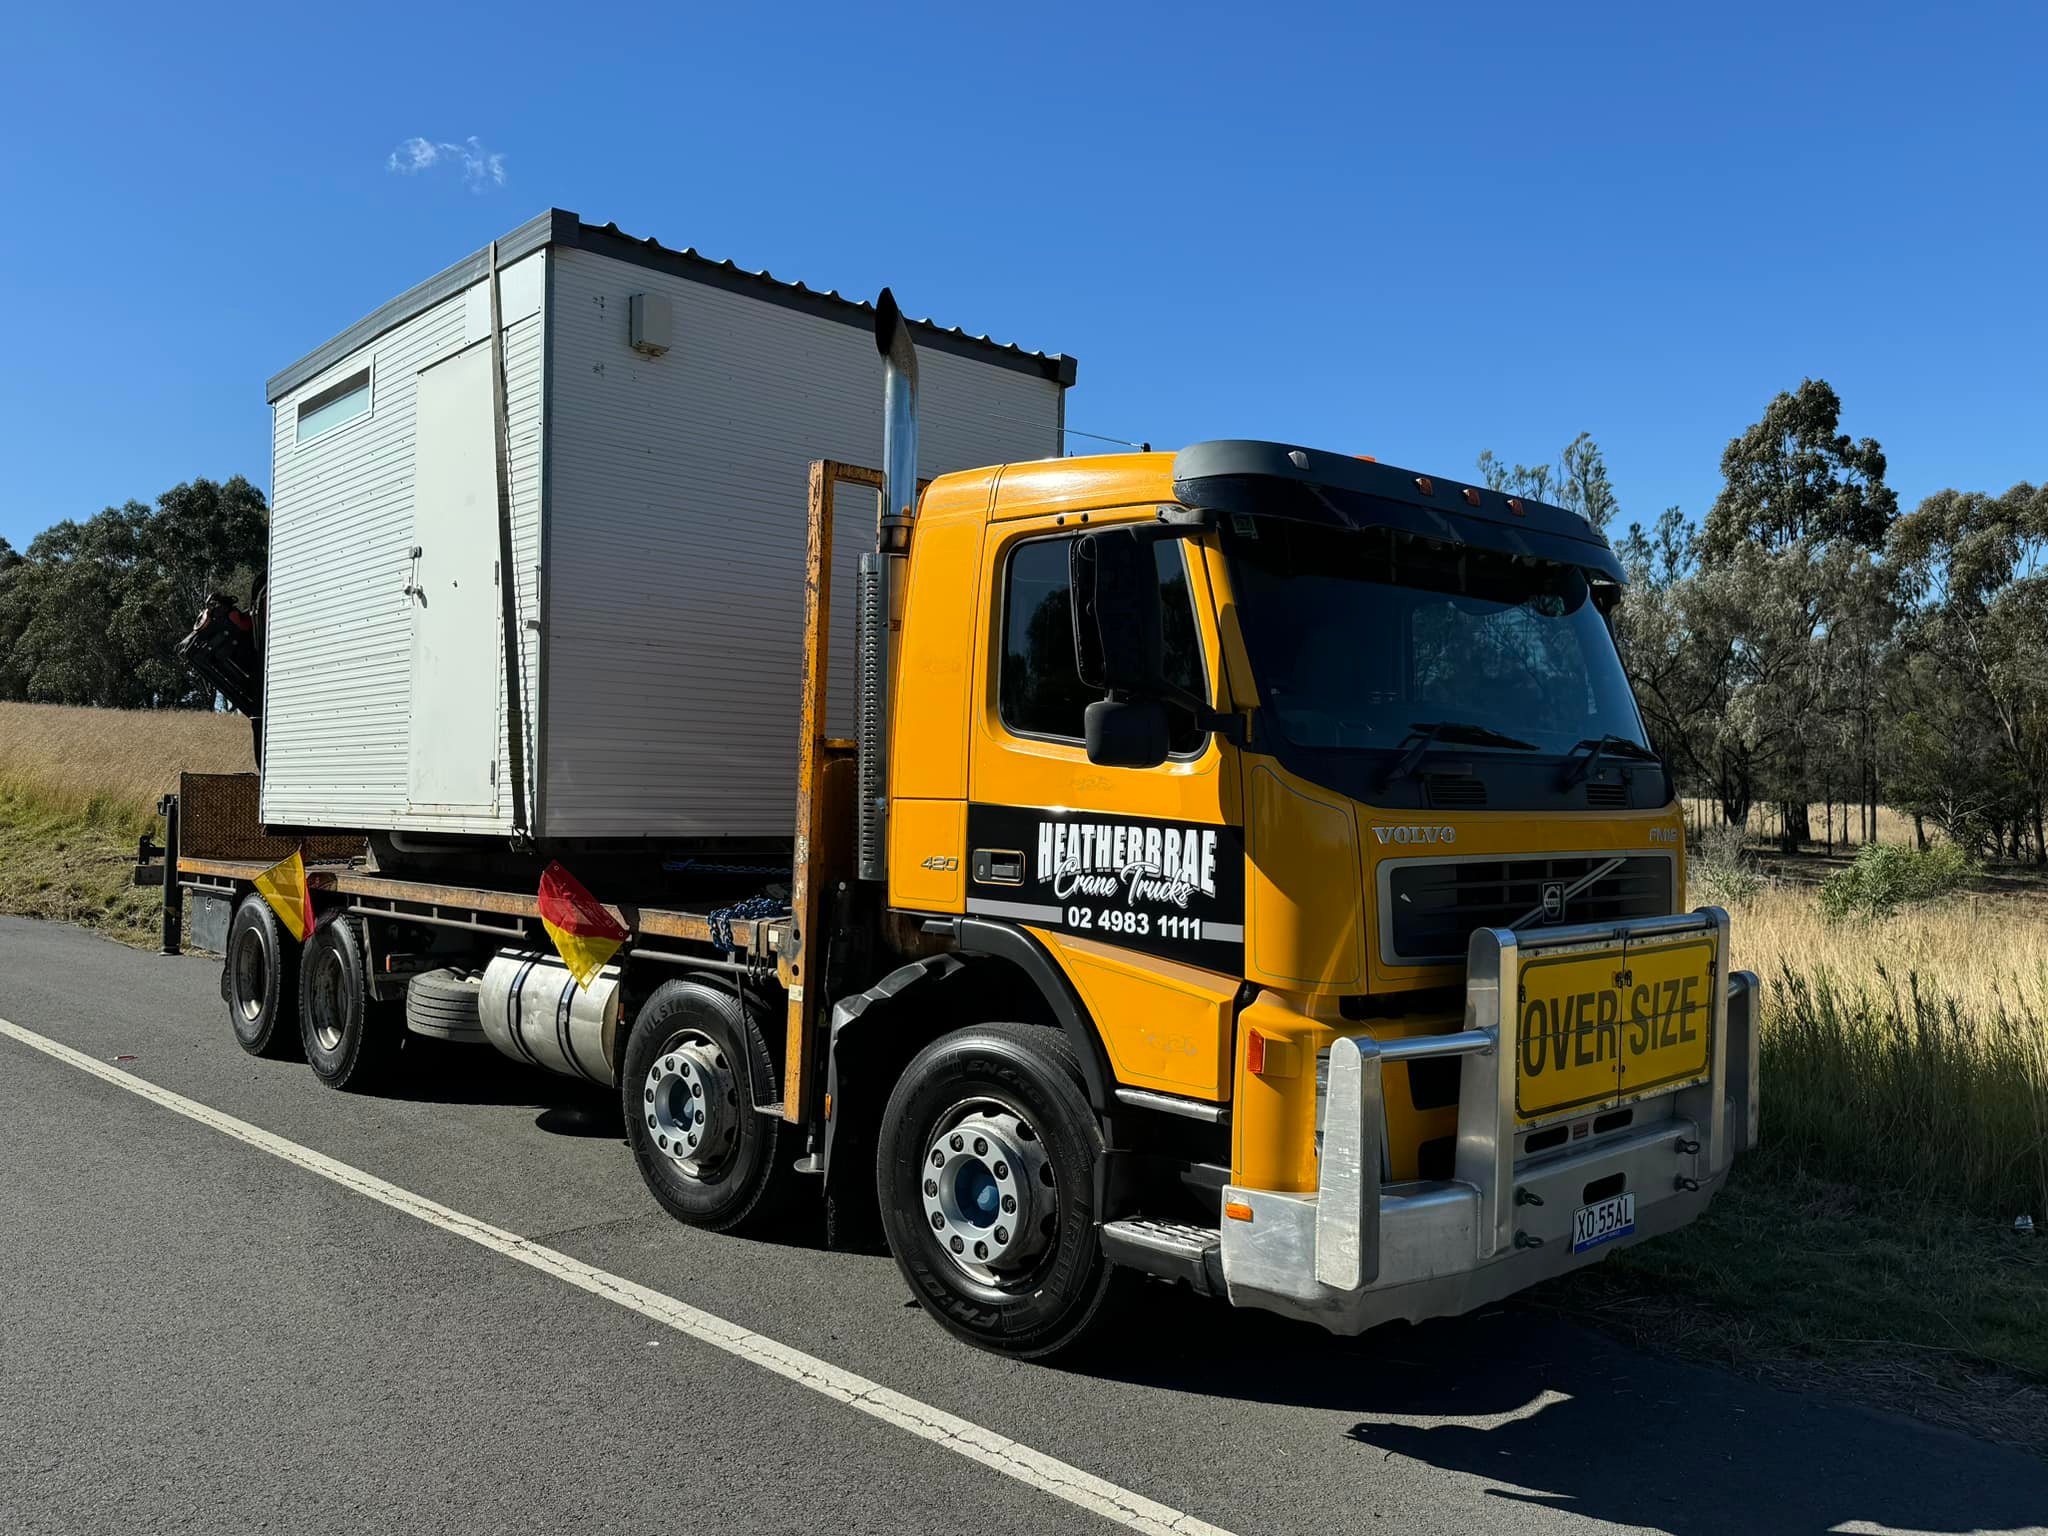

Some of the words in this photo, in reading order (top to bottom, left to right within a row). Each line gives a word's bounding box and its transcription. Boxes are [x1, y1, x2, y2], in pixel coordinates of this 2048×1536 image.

[1037, 822, 1217, 898] HEATHERBRAE
[1371, 826, 1456, 844] VOLVO
[1054, 857, 1118, 899] Crane
[1120, 861, 1194, 908] Trucks
[1068, 905, 1092, 928] 02
[1097, 908, 1150, 935] 4983
[1157, 916, 1200, 940] 1111
[1522, 989, 1618, 1077] OVER
[1629, 975, 1699, 1056] SIZE
